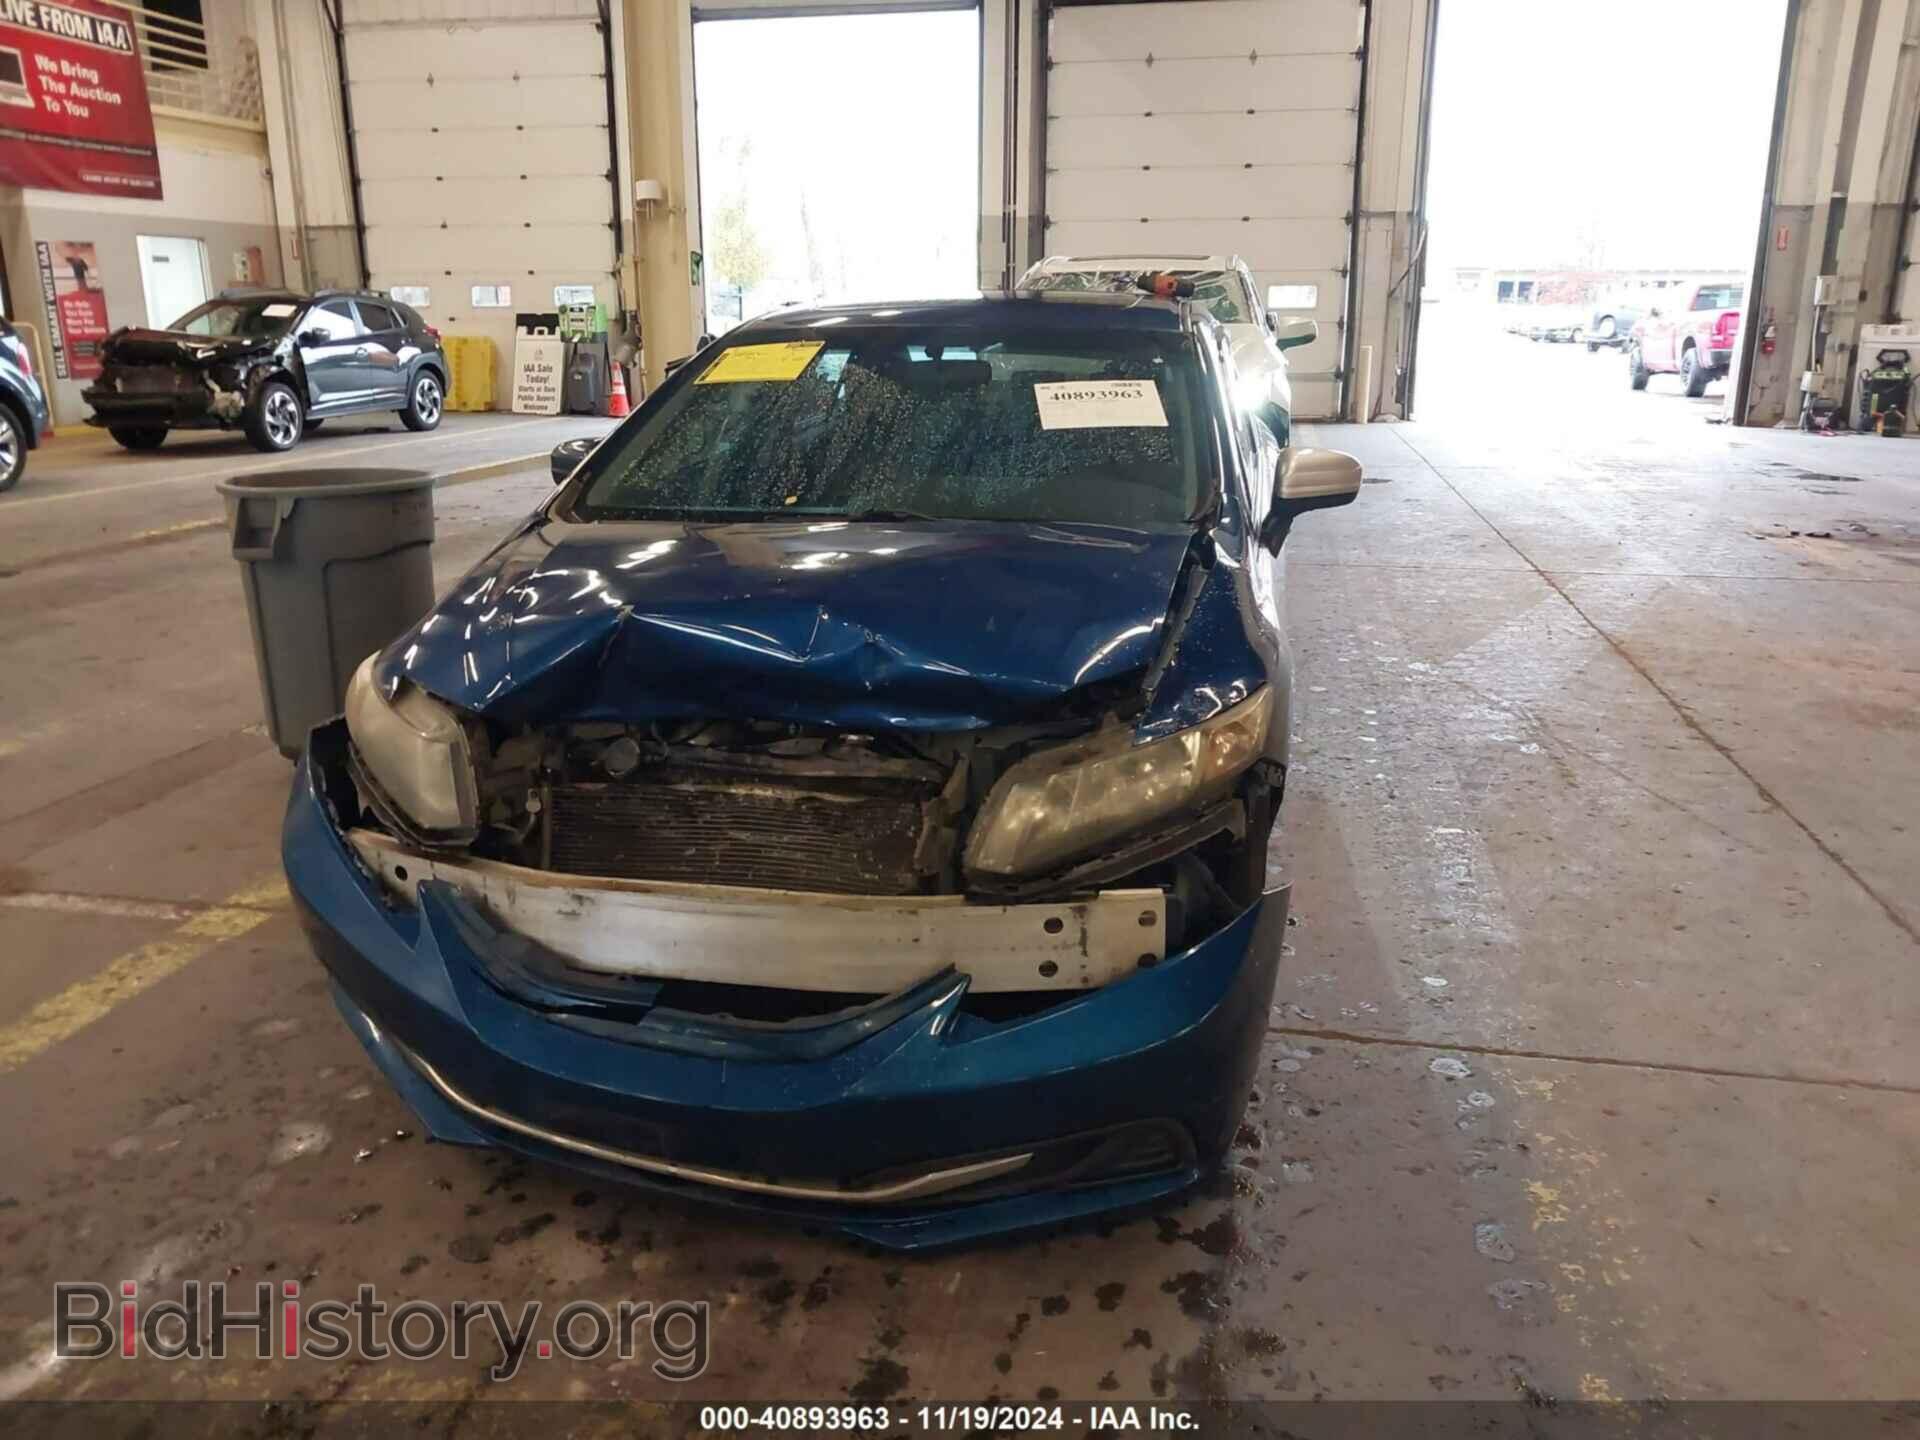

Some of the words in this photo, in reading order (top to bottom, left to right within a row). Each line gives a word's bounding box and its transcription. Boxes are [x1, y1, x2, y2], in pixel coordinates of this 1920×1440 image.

[0, 0, 37, 26] LIVE
[39, 5, 93, 40] FROM
[96, 20, 127, 50] IAA
[34, 53, 57, 74] We
[61, 60, 98, 85] Bring
[39, 75, 66, 94] The
[70, 82, 121, 105] Auction
[42, 95, 60, 112] To
[63, 99, 89, 117] You
[523, 364, 535, 373] IAA
[537, 363, 553, 373] Sale
[1050, 389, 1144, 401] 40893963
